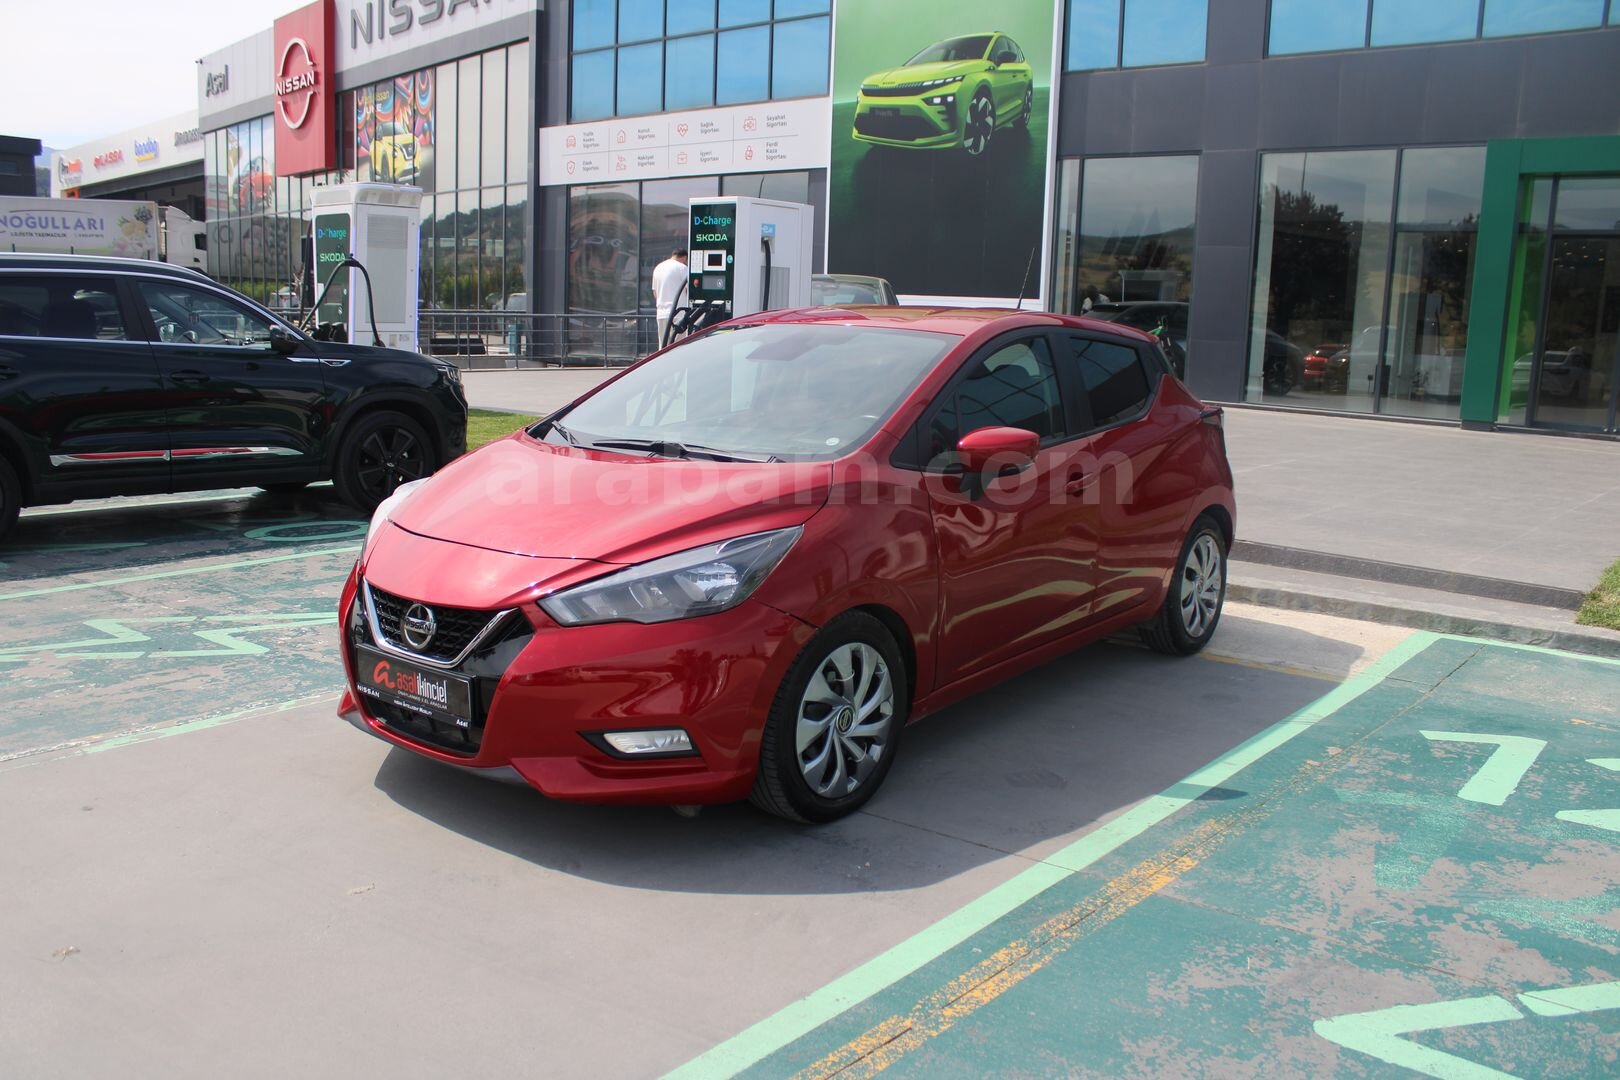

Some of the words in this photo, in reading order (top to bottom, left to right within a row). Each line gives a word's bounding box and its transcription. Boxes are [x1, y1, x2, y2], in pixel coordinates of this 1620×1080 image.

[351, 0, 491, 49] NISS
[206, 64, 229, 97] Asal
[275, 70, 315, 96] NISSAN
[694, 216, 732, 226] D-Charge
[357, 685, 380, 698] NISSAN
